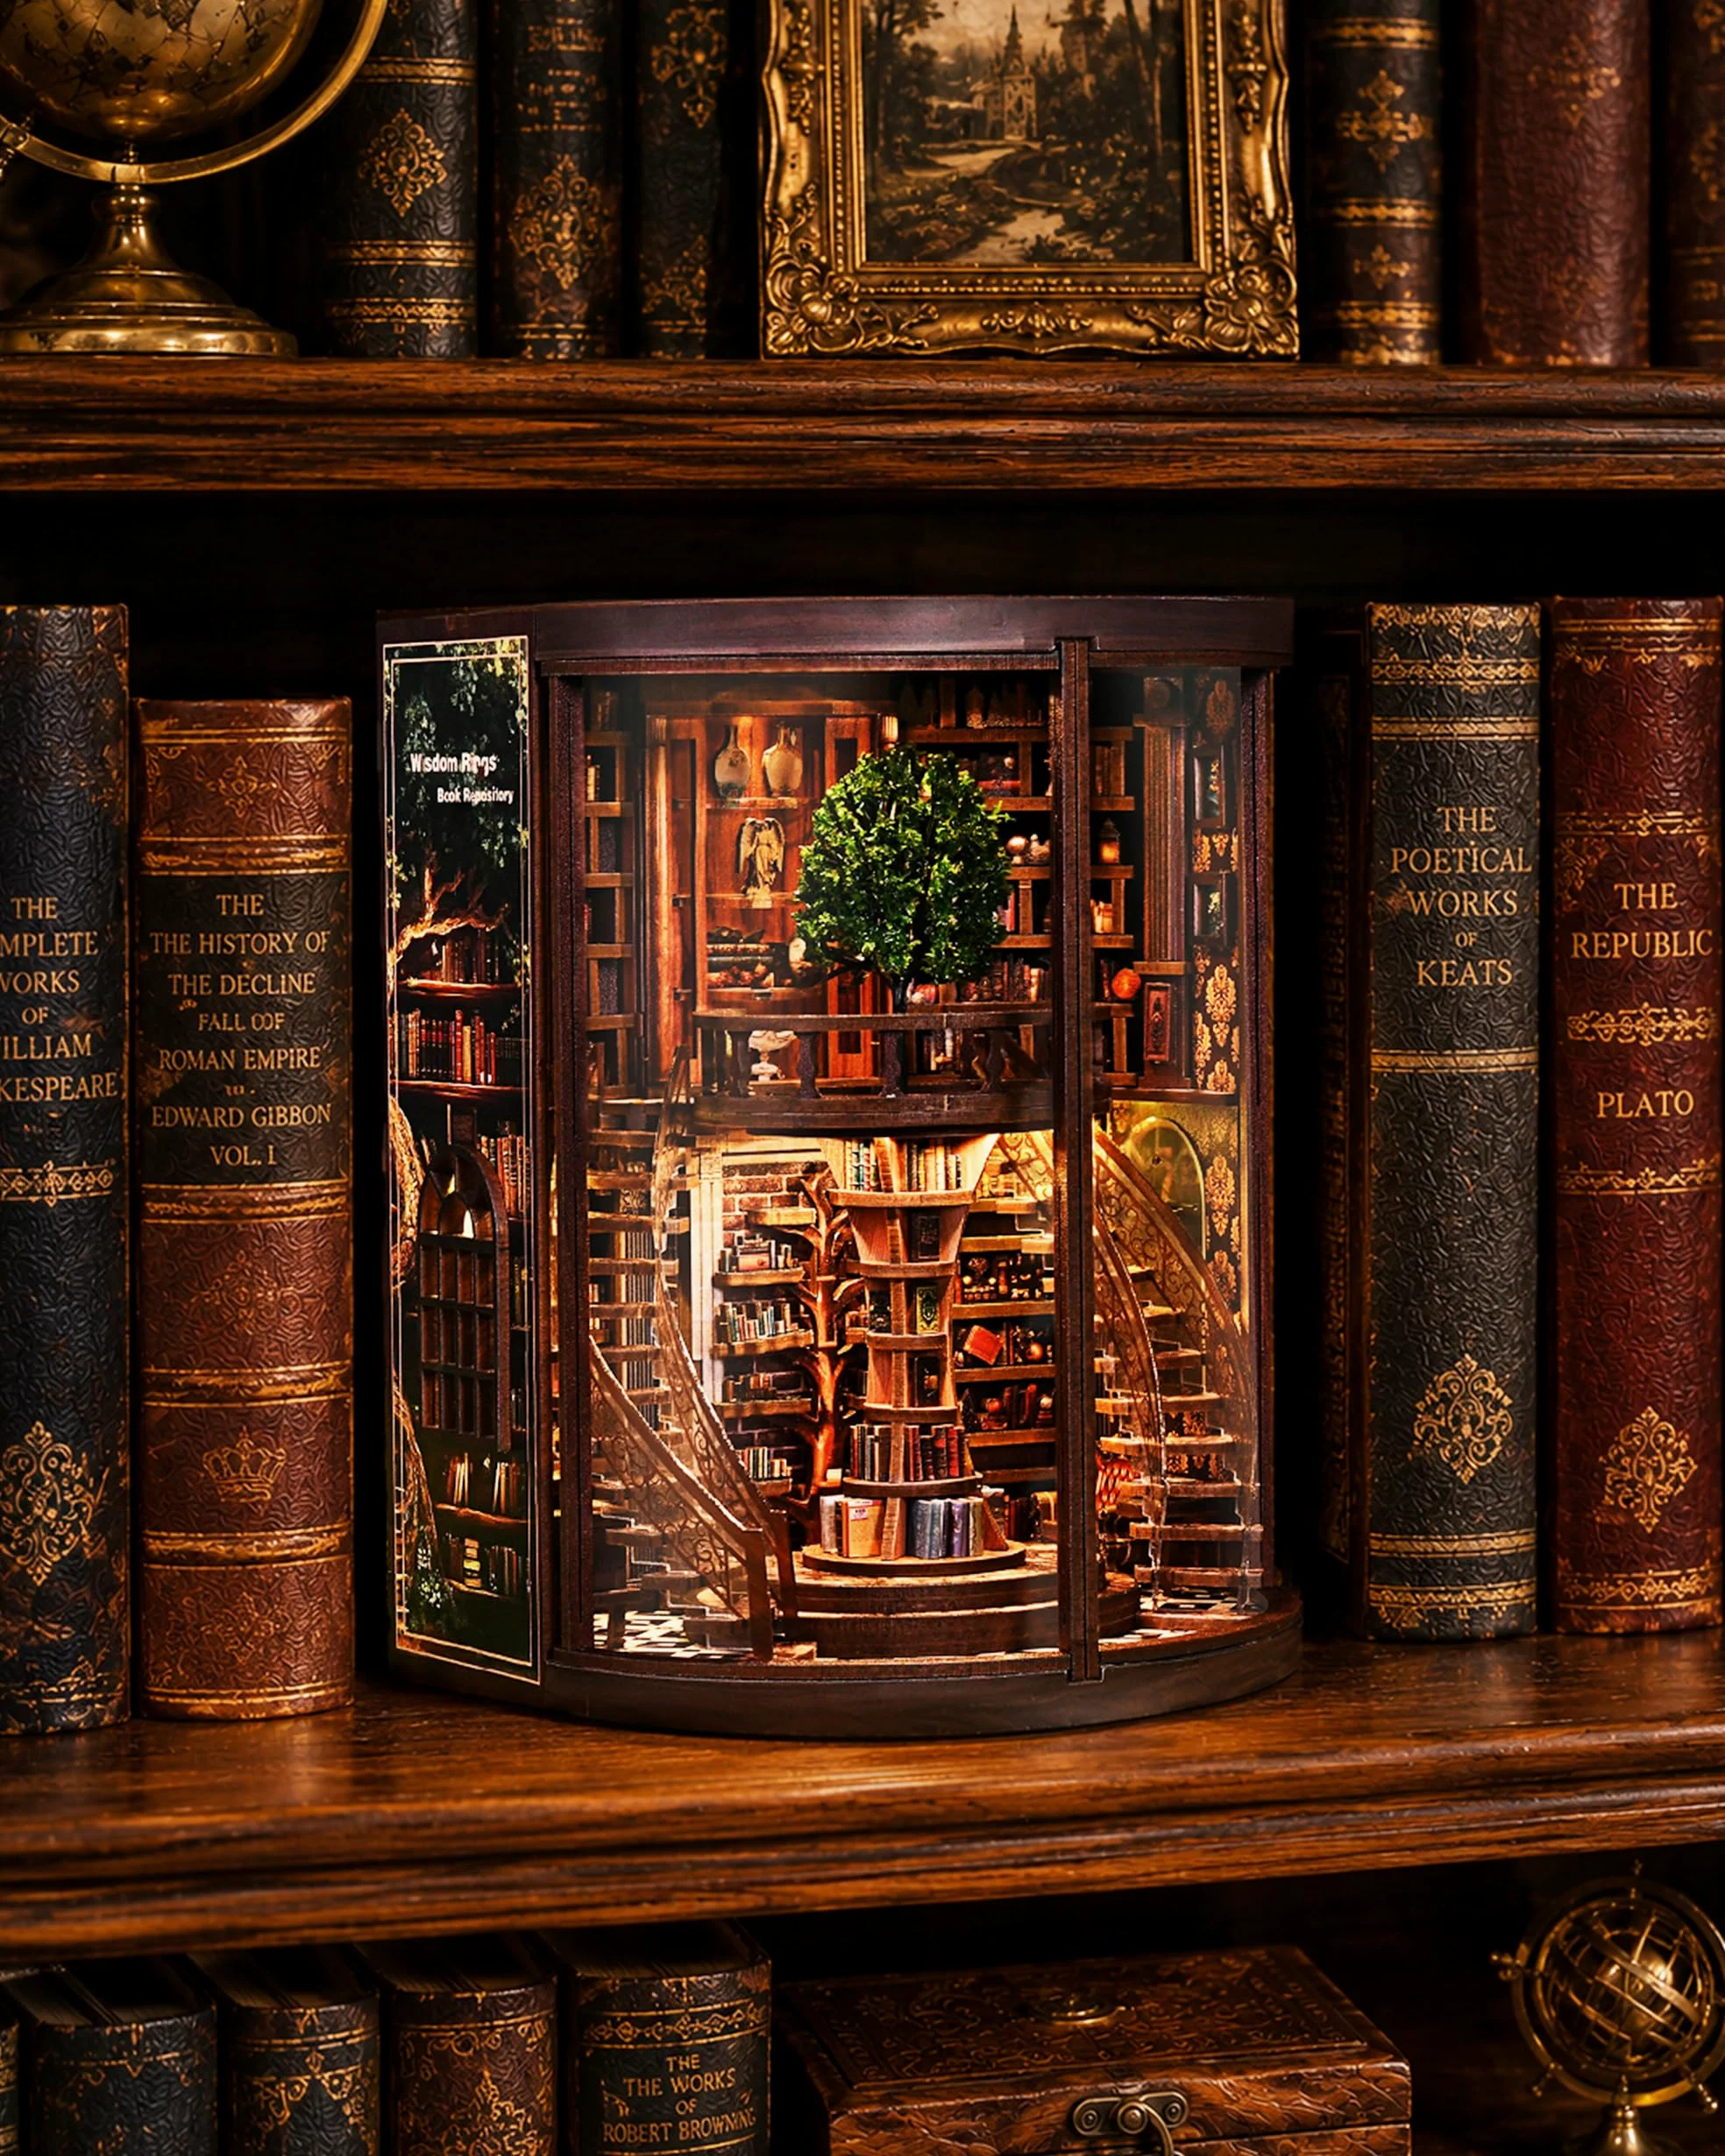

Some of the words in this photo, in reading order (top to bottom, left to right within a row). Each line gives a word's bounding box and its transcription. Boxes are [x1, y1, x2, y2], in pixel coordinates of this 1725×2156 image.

[437, 786, 461, 803] Book
[1438, 806, 1498, 833] THE
[1390, 847, 1533, 875] POETICAL
[11, 897, 58, 919] THE
[216, 894, 264, 916] THE
[1407, 890, 1519, 918] WORKS
[1614, 883, 1678, 910] THE
[149, 932, 192, 954] THE
[199, 932, 299, 955] HISTORY
[305, 930, 330, 953] OF
[1455, 932, 1477, 948] OF
[1571, 929, 1714, 960] REPUBLIC
[168, 973, 212, 996] THE
[219, 973, 316, 996] DECLINE
[1416, 960, 1514, 988] KEATS
[22, 1007, 49, 1025] OF
[198, 1012, 246, 1032] FALL
[0, 1033, 92, 1060] ILLIAM
[159, 1048, 236, 1071] ROMAN
[244, 1046, 322, 1070] EMPIRE
[152, 1105, 245, 1129] EDWARD
[251, 1103, 332, 1127] GIBBON
[1597, 1090, 1695, 1119] PLATO
[666, 2053, 700, 2073] THE
[623, 2077, 664, 2097] THE
[670, 2067, 736, 2095] WORKS
[675, 2098, 698, 2116] OF
[603, 2121, 673, 2144] ROBERT
